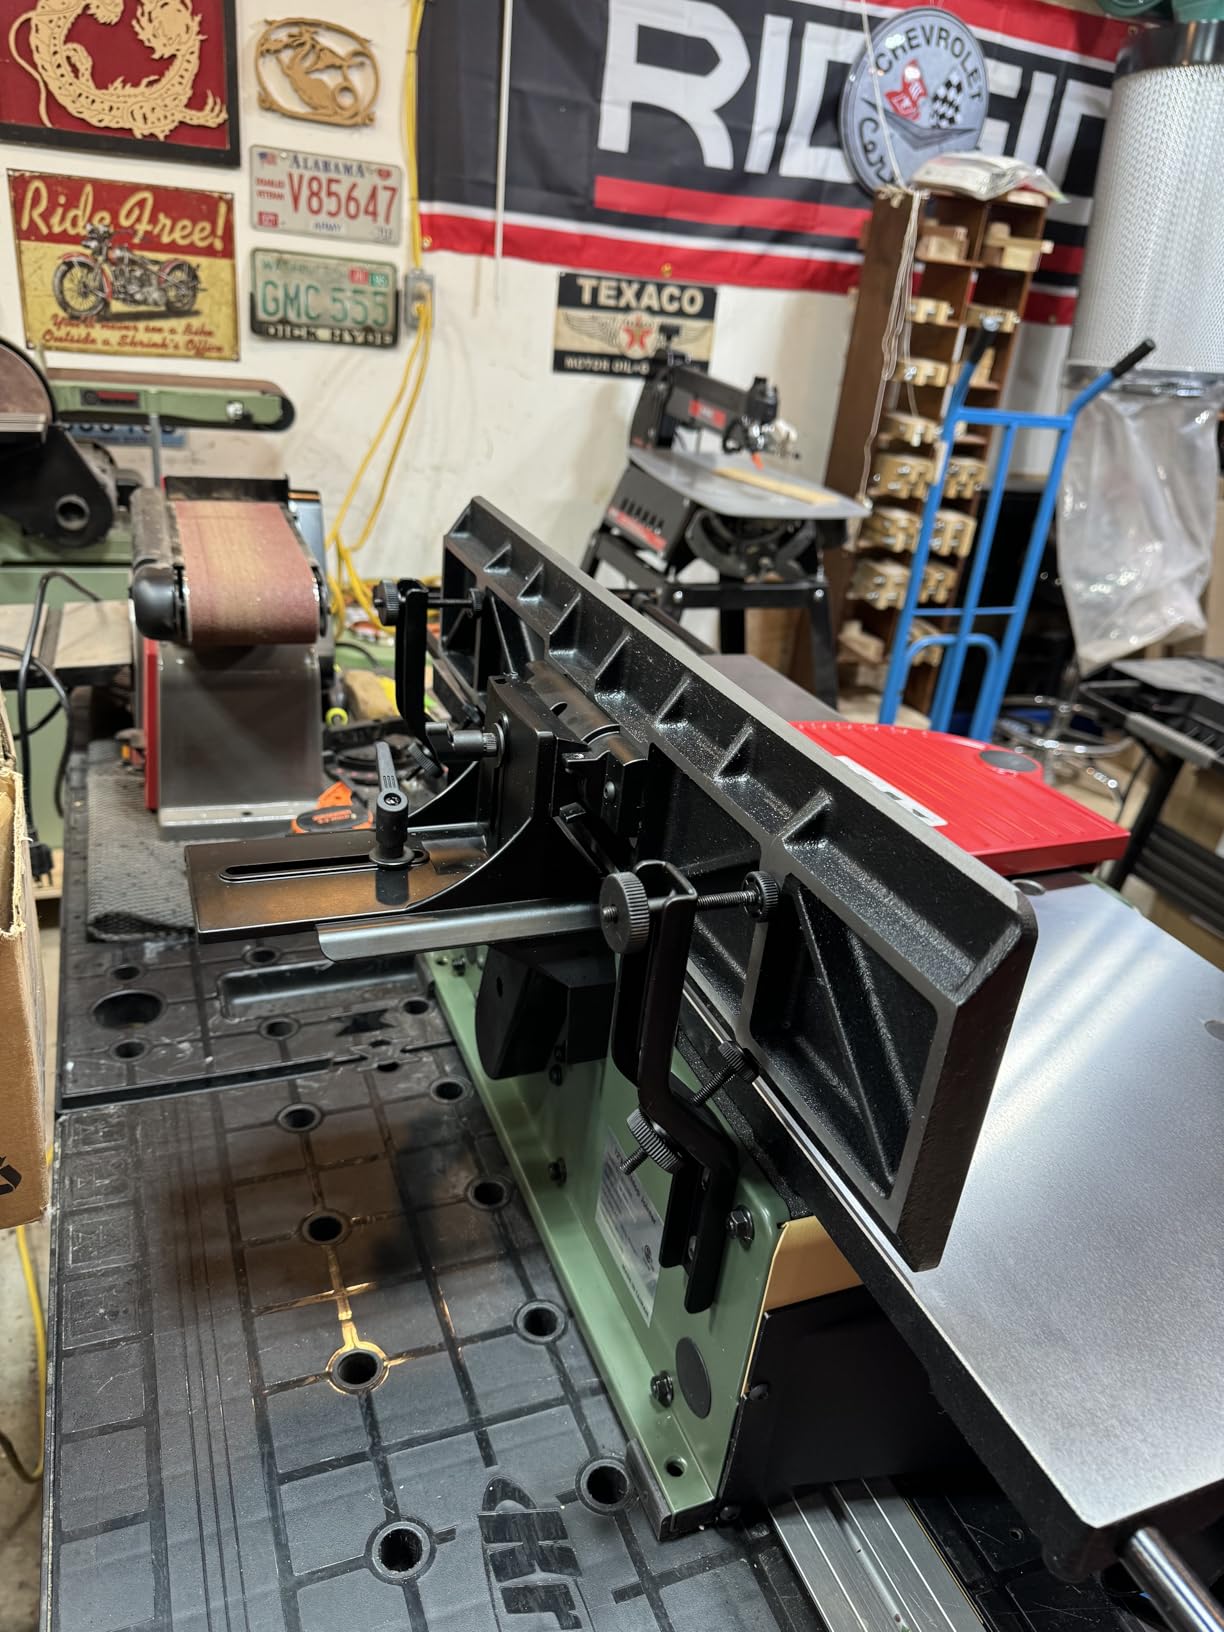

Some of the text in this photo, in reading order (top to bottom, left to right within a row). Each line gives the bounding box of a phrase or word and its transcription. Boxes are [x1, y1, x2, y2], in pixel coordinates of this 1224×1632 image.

[875, 24, 982, 101] CHEVROLET
[289, 154, 365, 178] ALABAMA
[20, 179, 229, 252] Ride Free!
[288, 171, 399, 225] V85647
[262, 280, 389, 327] GMC 555
[576, 276, 705, 316] TEXACO
[42, 328, 98, 346] Outside
[118, 334, 181, 352] Shrink's
[185, 339, 226, 356] Office
[563, 355, 611, 373] MOTOR
